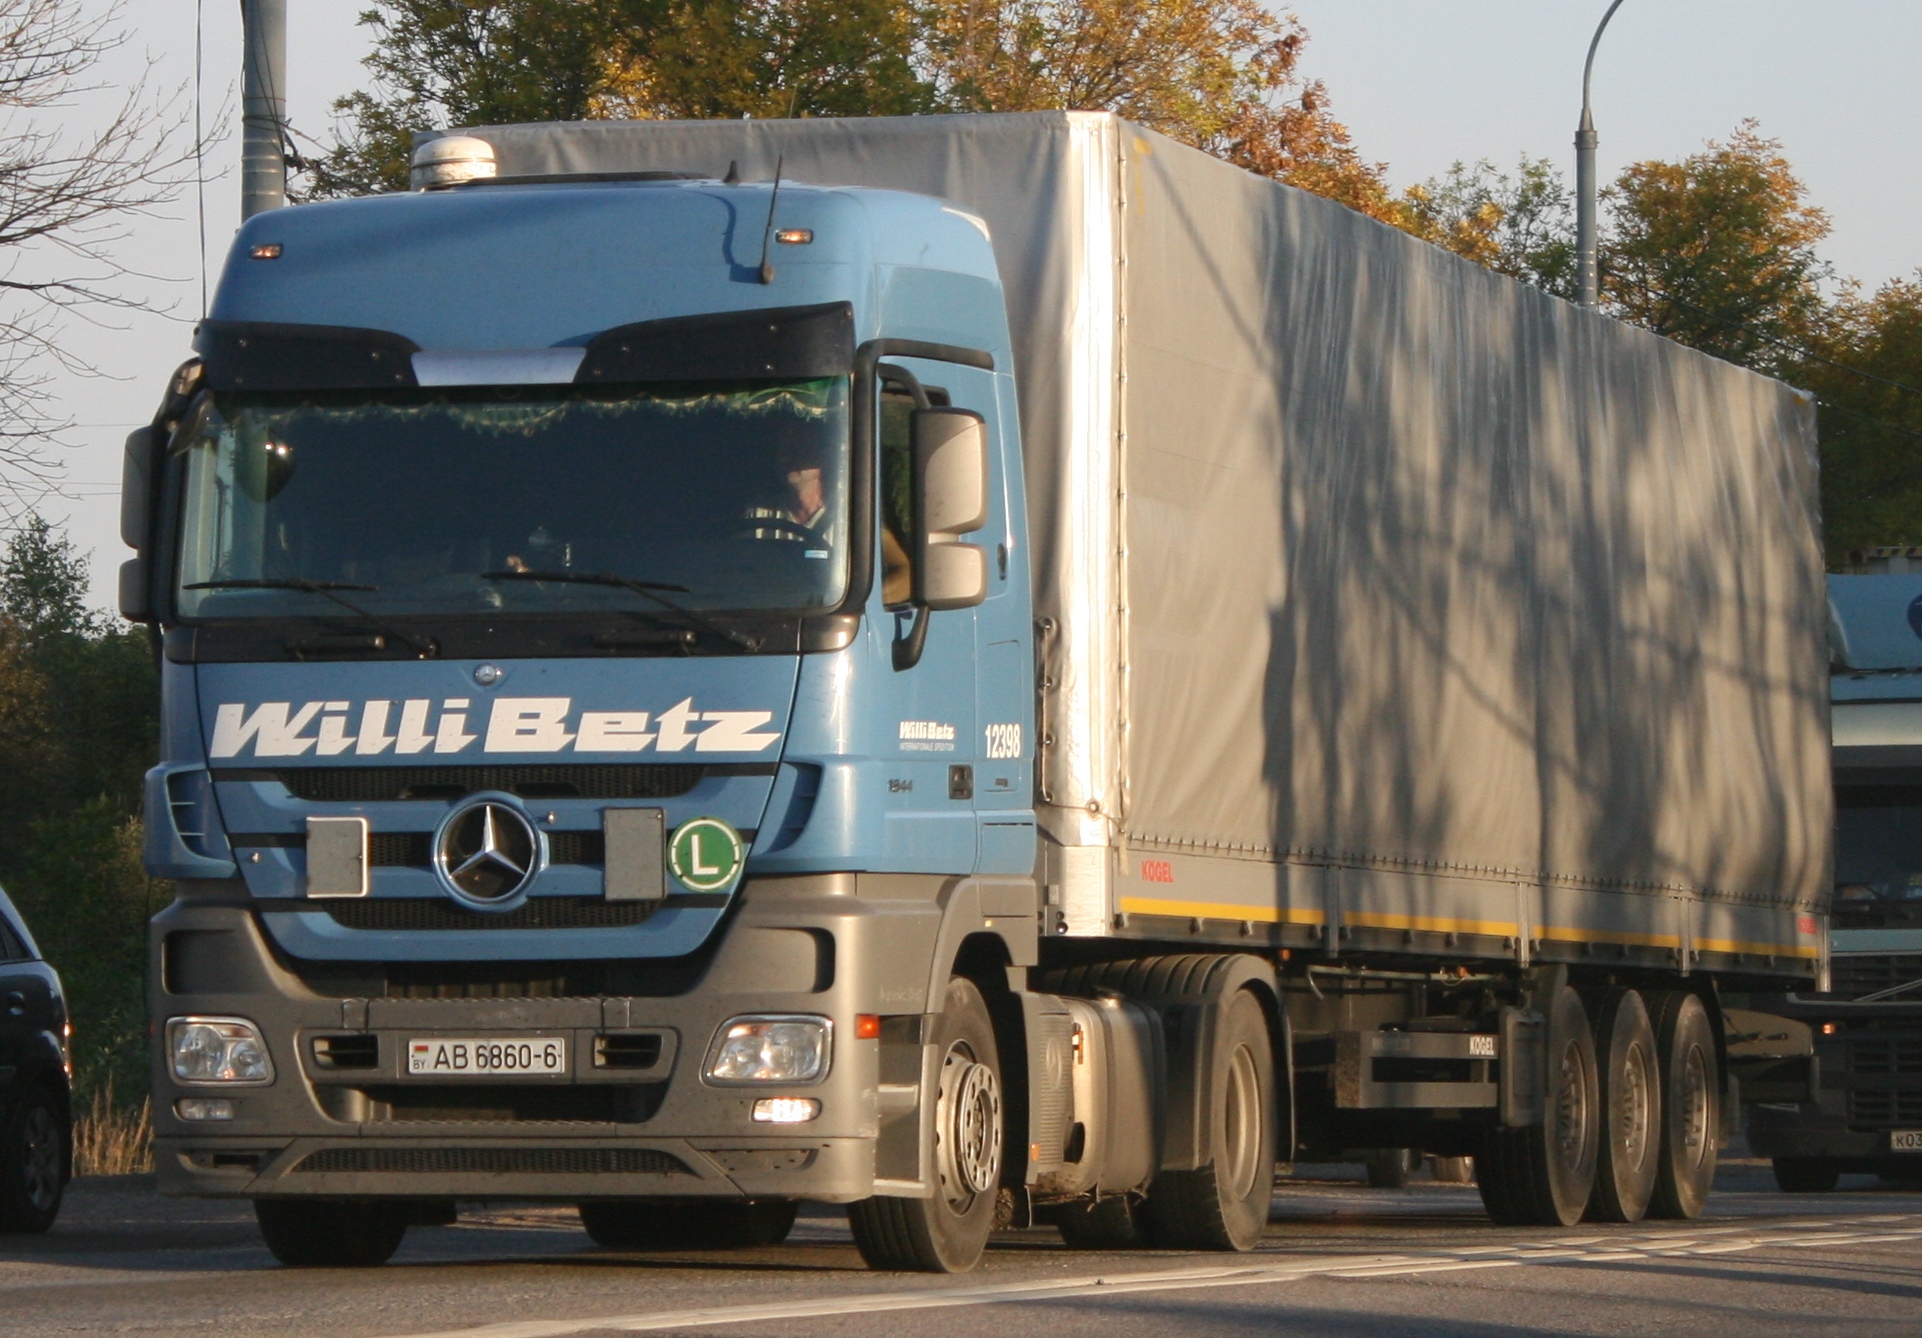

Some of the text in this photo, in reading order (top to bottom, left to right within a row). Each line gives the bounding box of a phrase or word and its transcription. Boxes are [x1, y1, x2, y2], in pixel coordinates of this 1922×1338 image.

[210, 696, 781, 758] Willi Betz
[899, 721, 955, 740] Willi Betz
[985, 723, 1021, 758] 12398
[691, 834, 719, 875] L
[434, 1044, 558, 1069] AB 6860-6
